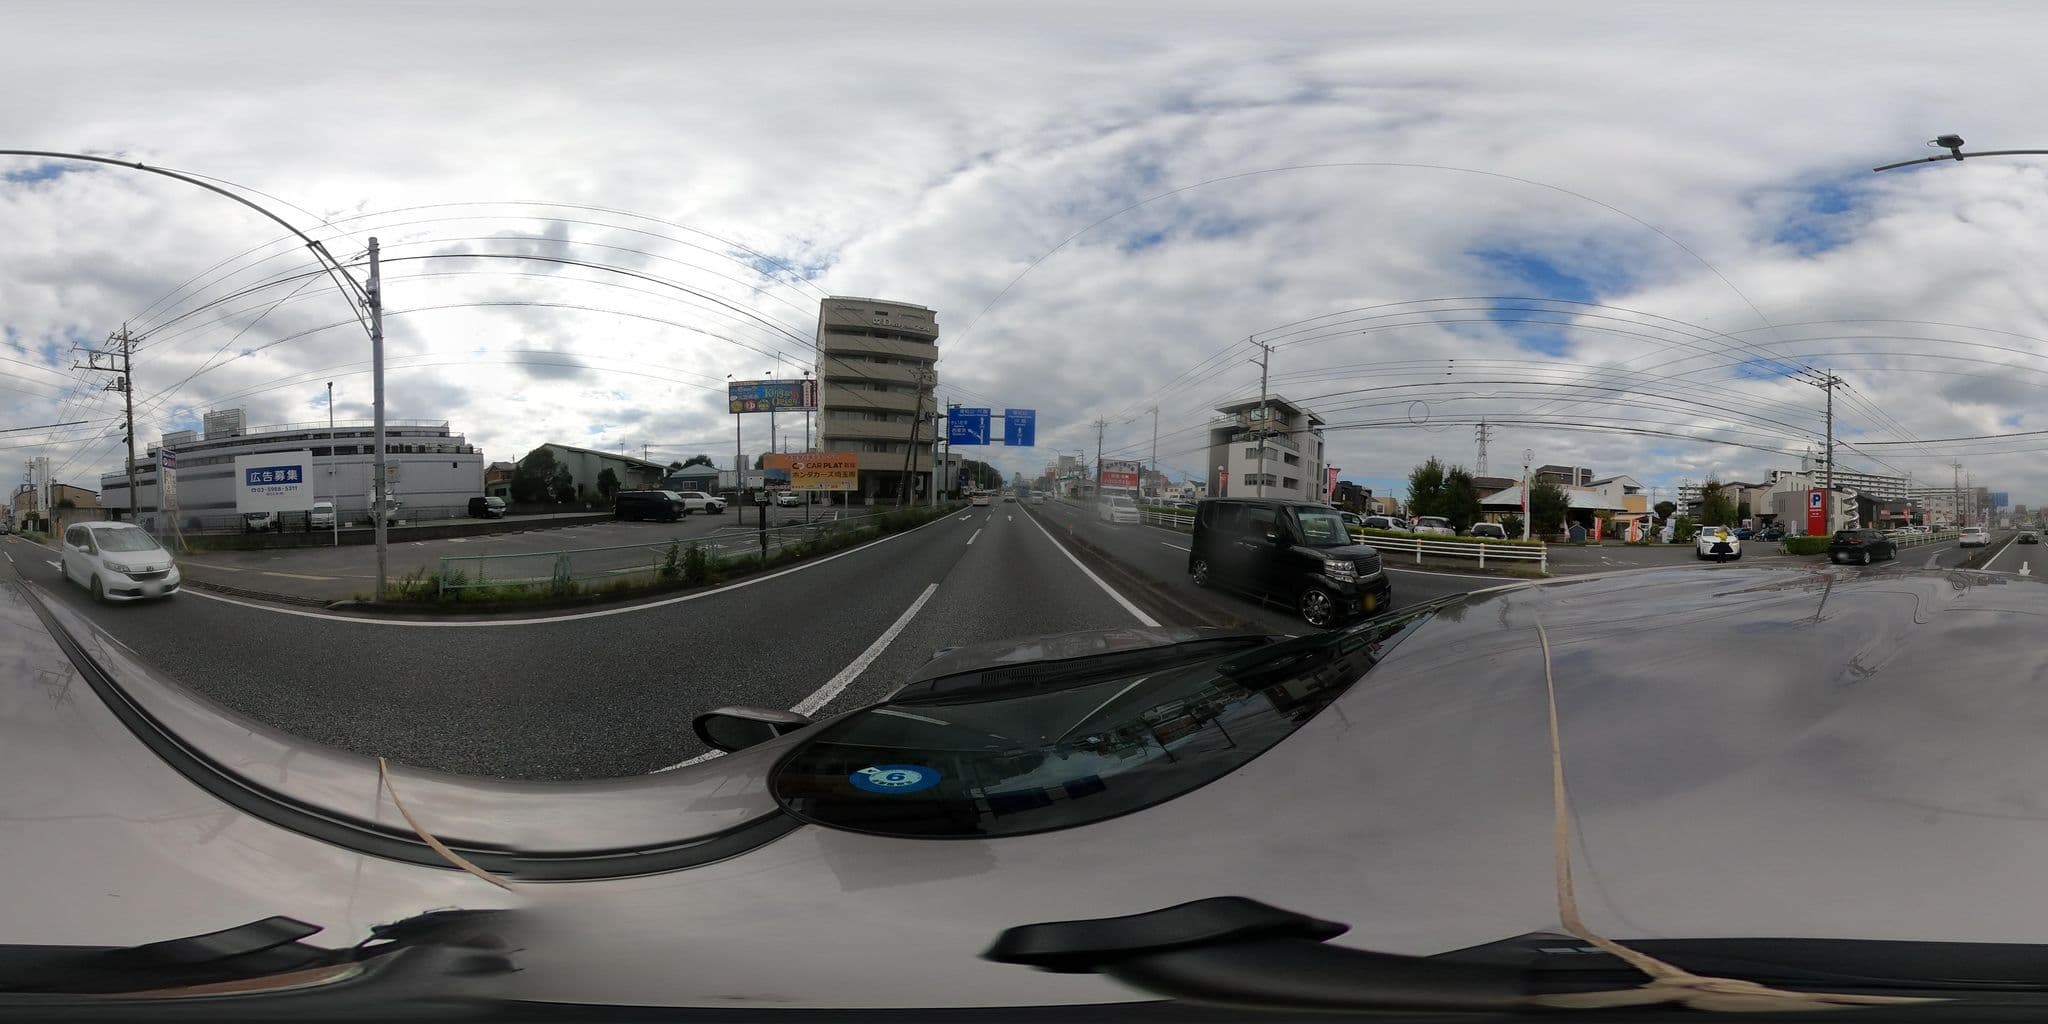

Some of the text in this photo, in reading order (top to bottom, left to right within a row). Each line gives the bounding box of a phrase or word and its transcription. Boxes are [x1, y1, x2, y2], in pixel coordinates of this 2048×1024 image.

[250, 470, 297, 482] 広告募集
[1813, 494, 1820, 505] P
[886, 772, 906, 781] 6
